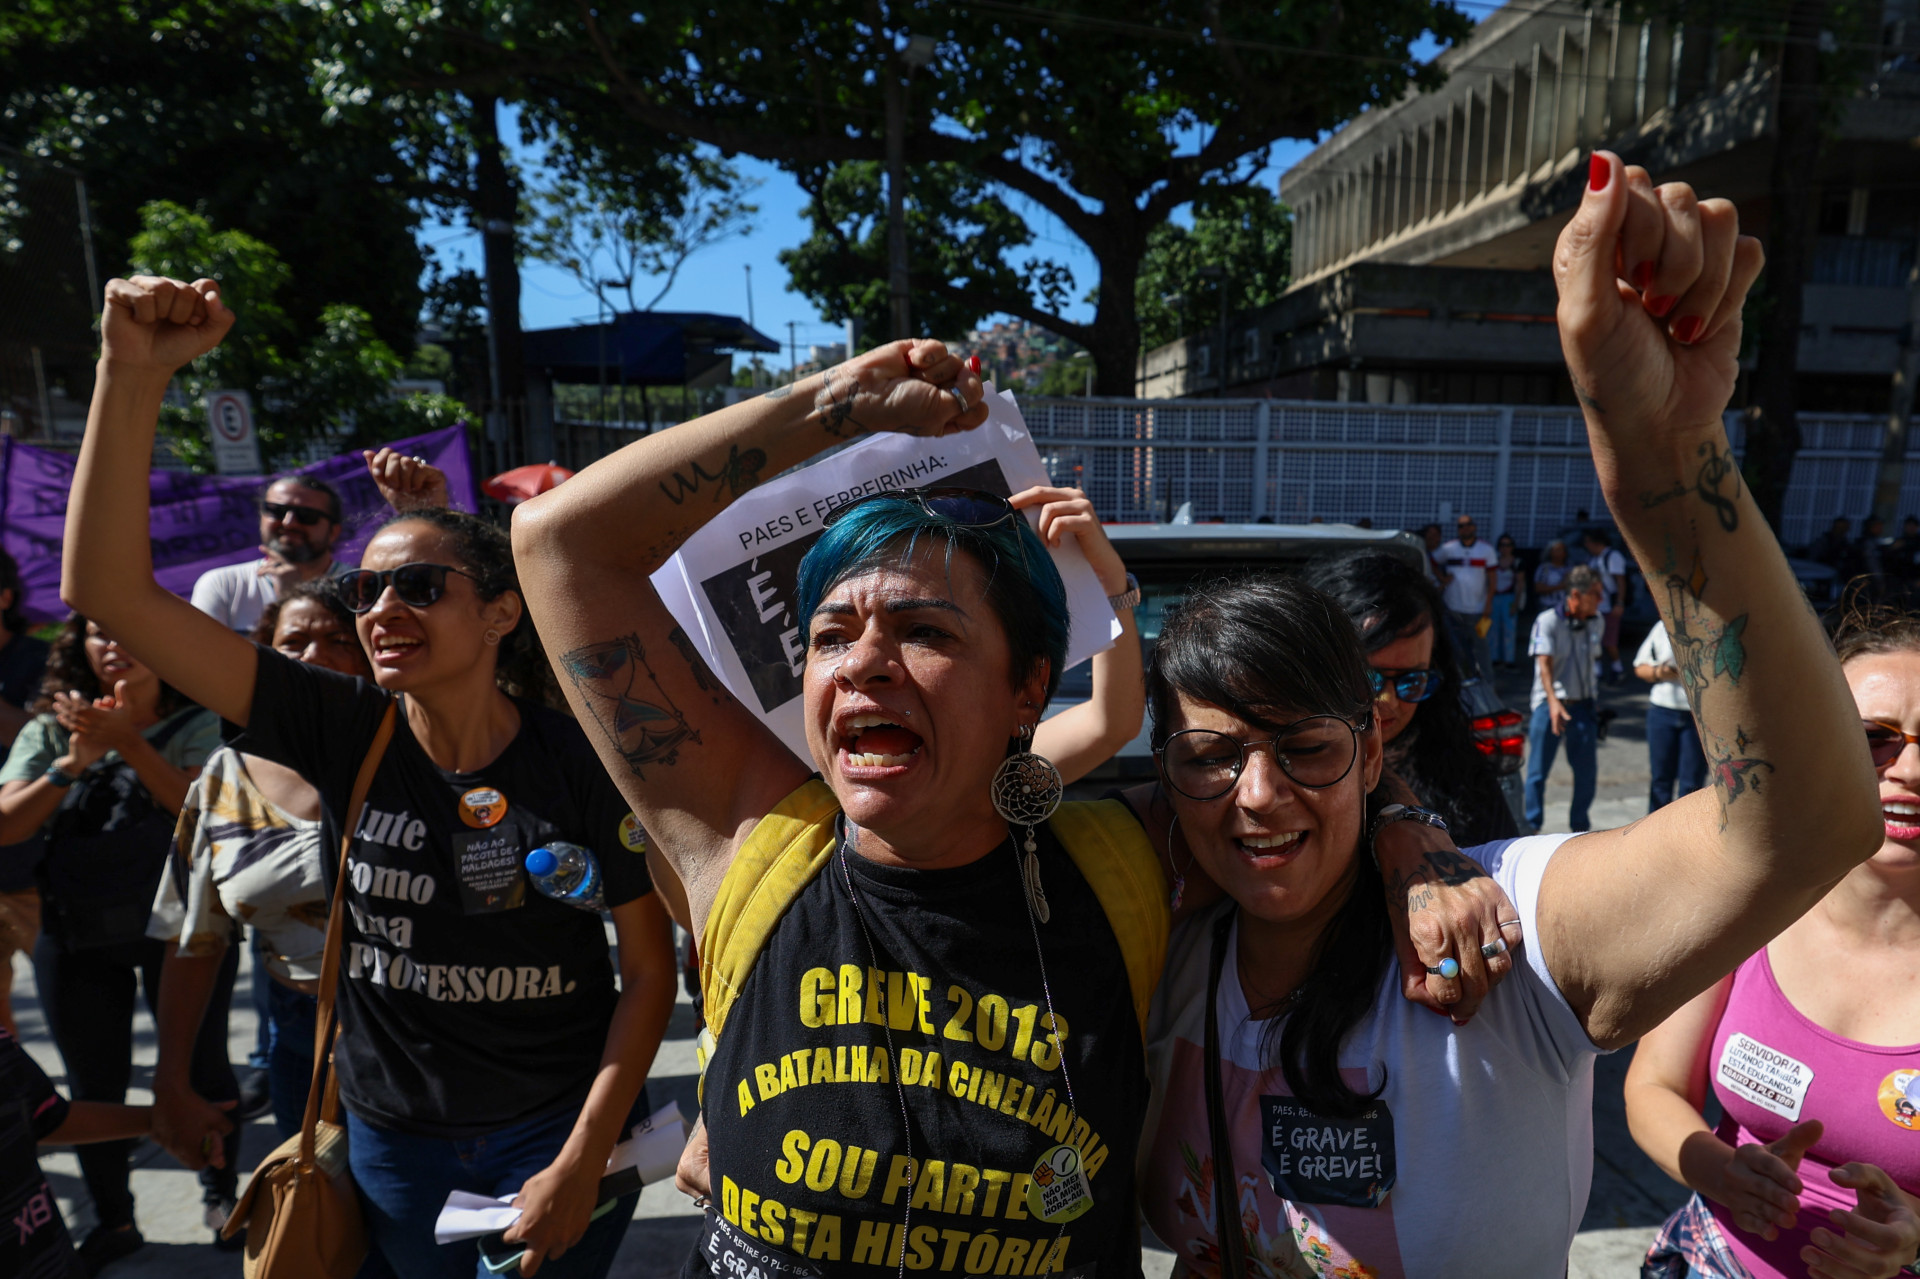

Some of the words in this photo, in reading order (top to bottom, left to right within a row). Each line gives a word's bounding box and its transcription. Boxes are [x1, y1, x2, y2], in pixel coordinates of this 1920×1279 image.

[739, 515, 794, 550] PAES
[795, 507, 812, 526] E
[747, 557, 785, 624] É
[461, 849, 499, 865] PACOTE
[461, 855, 516, 874] MALDADES!
[467, 840, 489, 852] NÃO
[491, 838, 505, 848] AO
[349, 941, 577, 1002] PROFESSORA.
[800, 964, 935, 1035] GREVE
[943, 985, 1069, 1071] 2013
[1729, 1046, 1764, 1069] LUTANDO
[1766, 1064, 1802, 1087] TAMBÉM
[1738, 1038, 1800, 1076] SERVIDOR/A
[1723, 1066, 1749, 1085] ABAIXO
[1749, 1081, 1757, 1090] O
[1757, 1086, 1775, 1099] PLC
[1775, 1093, 1794, 1109] 186!
[737, 1078, 755, 1117] A
[755, 1045, 889, 1101] BATALHA
[901, 1048, 941, 1088] DA
[950, 1061, 1109, 1181] CINELÂNDIA
[1272, 1105, 1295, 1116] PAES,
[1272, 1118, 1283, 1146] É
[1290, 1126, 1377, 1153] GRAVE,
[775, 1129, 878, 1199] SOU
[881, 1155, 1031, 1221] PARTE
[1280, 1147, 1292, 1175] É
[1298, 1154, 1382, 1181] GREVE!
[1043, 1185, 1061, 1201] NÃO
[1046, 1195, 1058, 1208] NA
[708, 1230, 720, 1255] É
[722, 1175, 841, 1260] DESTA
[852, 1221, 1071, 1277] HISTÓRIA
[715, 1215, 732, 1239] PAES,
[733, 1235, 759, 1259] RETIRE
[761, 1255, 769, 1263] O
[770, 1259, 790, 1272] PLC
[792, 1266, 809, 1277] 186
